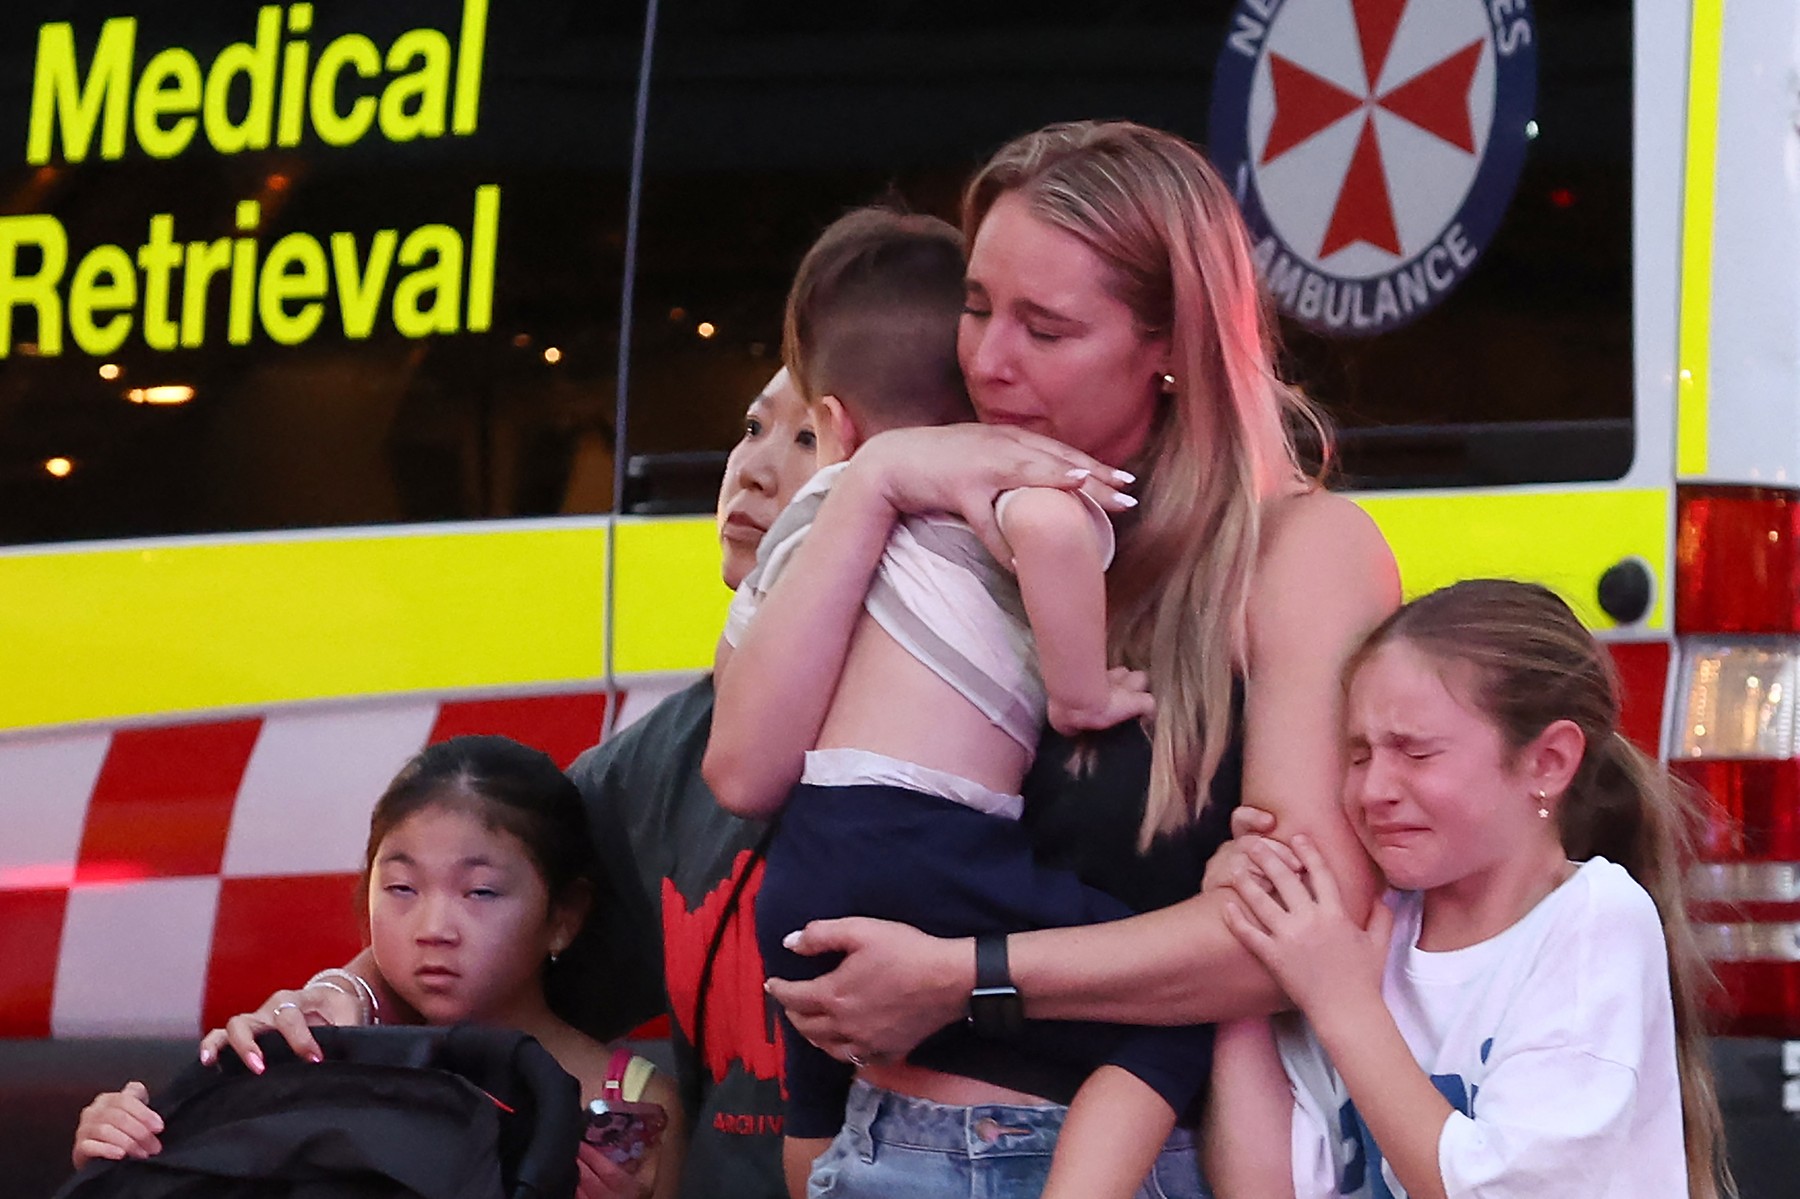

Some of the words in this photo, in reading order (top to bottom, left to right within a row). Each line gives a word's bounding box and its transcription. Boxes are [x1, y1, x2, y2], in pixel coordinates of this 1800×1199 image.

[26, 0, 489, 165] Medical
[0, 184, 500, 359] Retrieval
[1253, 223, 1477, 326] AMBULANCE
